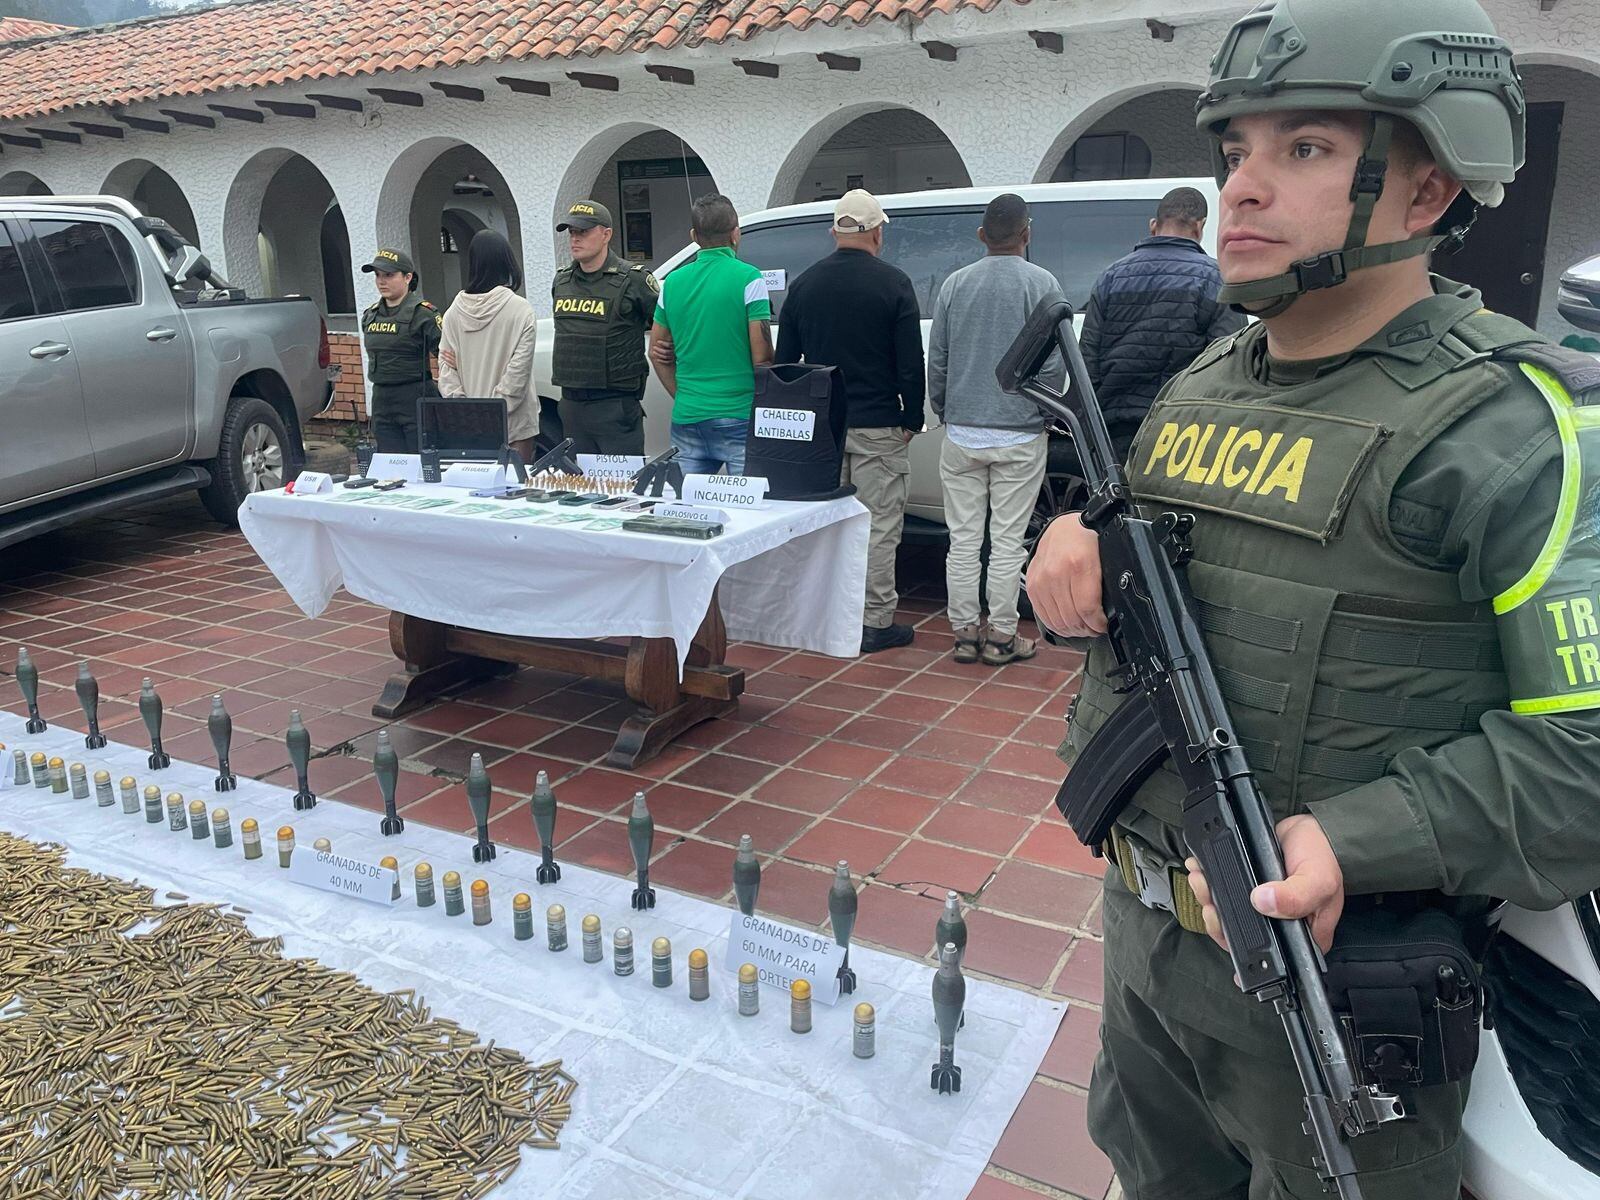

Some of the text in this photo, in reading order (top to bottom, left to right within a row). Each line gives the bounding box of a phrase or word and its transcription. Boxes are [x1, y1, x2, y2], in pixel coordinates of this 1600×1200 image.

[555, 298, 605, 316] POLICIA
[367, 322, 396, 333] POLICIA
[762, 409, 807, 422] CHALECO
[757, 426, 811, 440] ANTIBALAS
[596, 455, 629, 464] PISTOLA
[1143, 422, 1313, 503] POLICIA
[588, 468, 613, 478] GLOCK
[615, 469, 624, 478] 17
[708, 475, 748, 487] DINERO
[694, 490, 755, 505] INCAUTADO
[663, 509, 708, 521] EXPLOSIVO C4
[1546, 595, 1600, 641] TR
[316, 852, 381, 880] GRANADAS DE
[329, 875, 362, 894] 40 MM
[742, 915, 830, 955] GRANADAS DE
[742, 939, 816, 976] 60 MM PARA
[758, 968, 793, 990] ORTE
